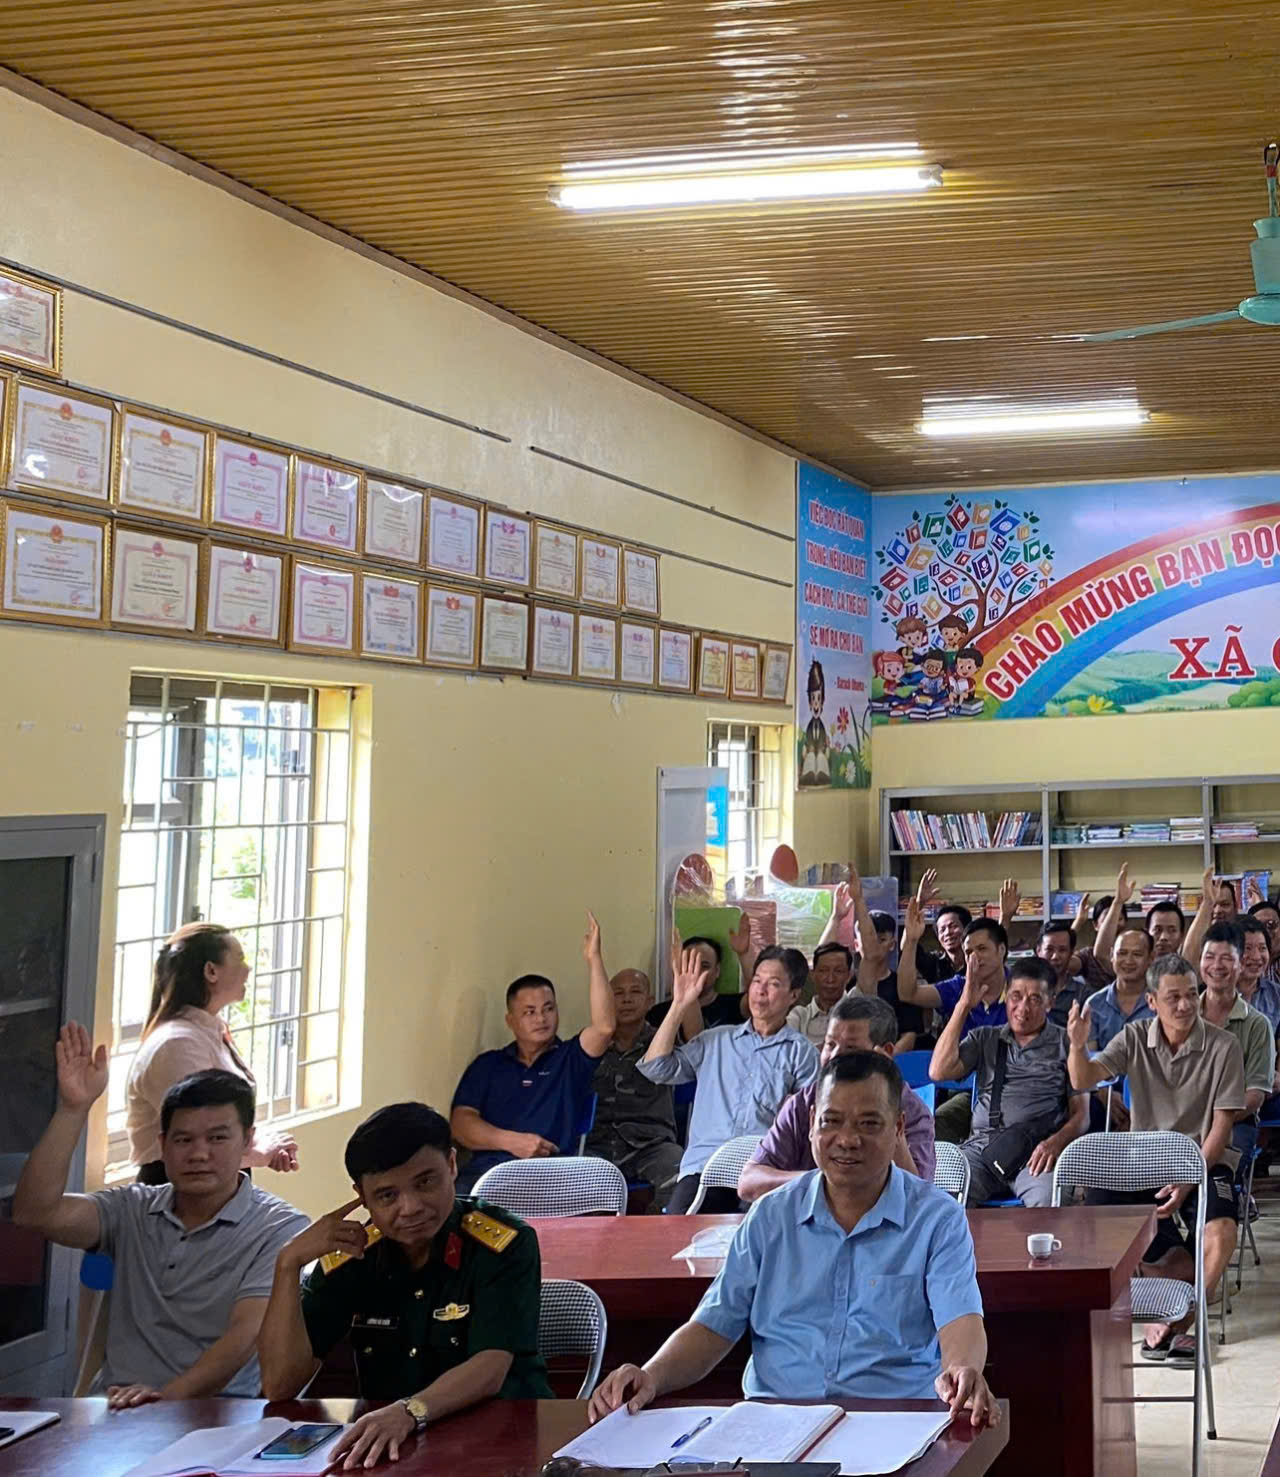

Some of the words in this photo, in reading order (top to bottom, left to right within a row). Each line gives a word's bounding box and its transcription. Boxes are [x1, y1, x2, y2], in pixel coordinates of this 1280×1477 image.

[985, 623, 1062, 699] CHÀO
[1059, 565, 1155, 637] MỪNG
[1156, 539, 1225, 586] BẠN
[1169, 624, 1255, 679] XÃ
